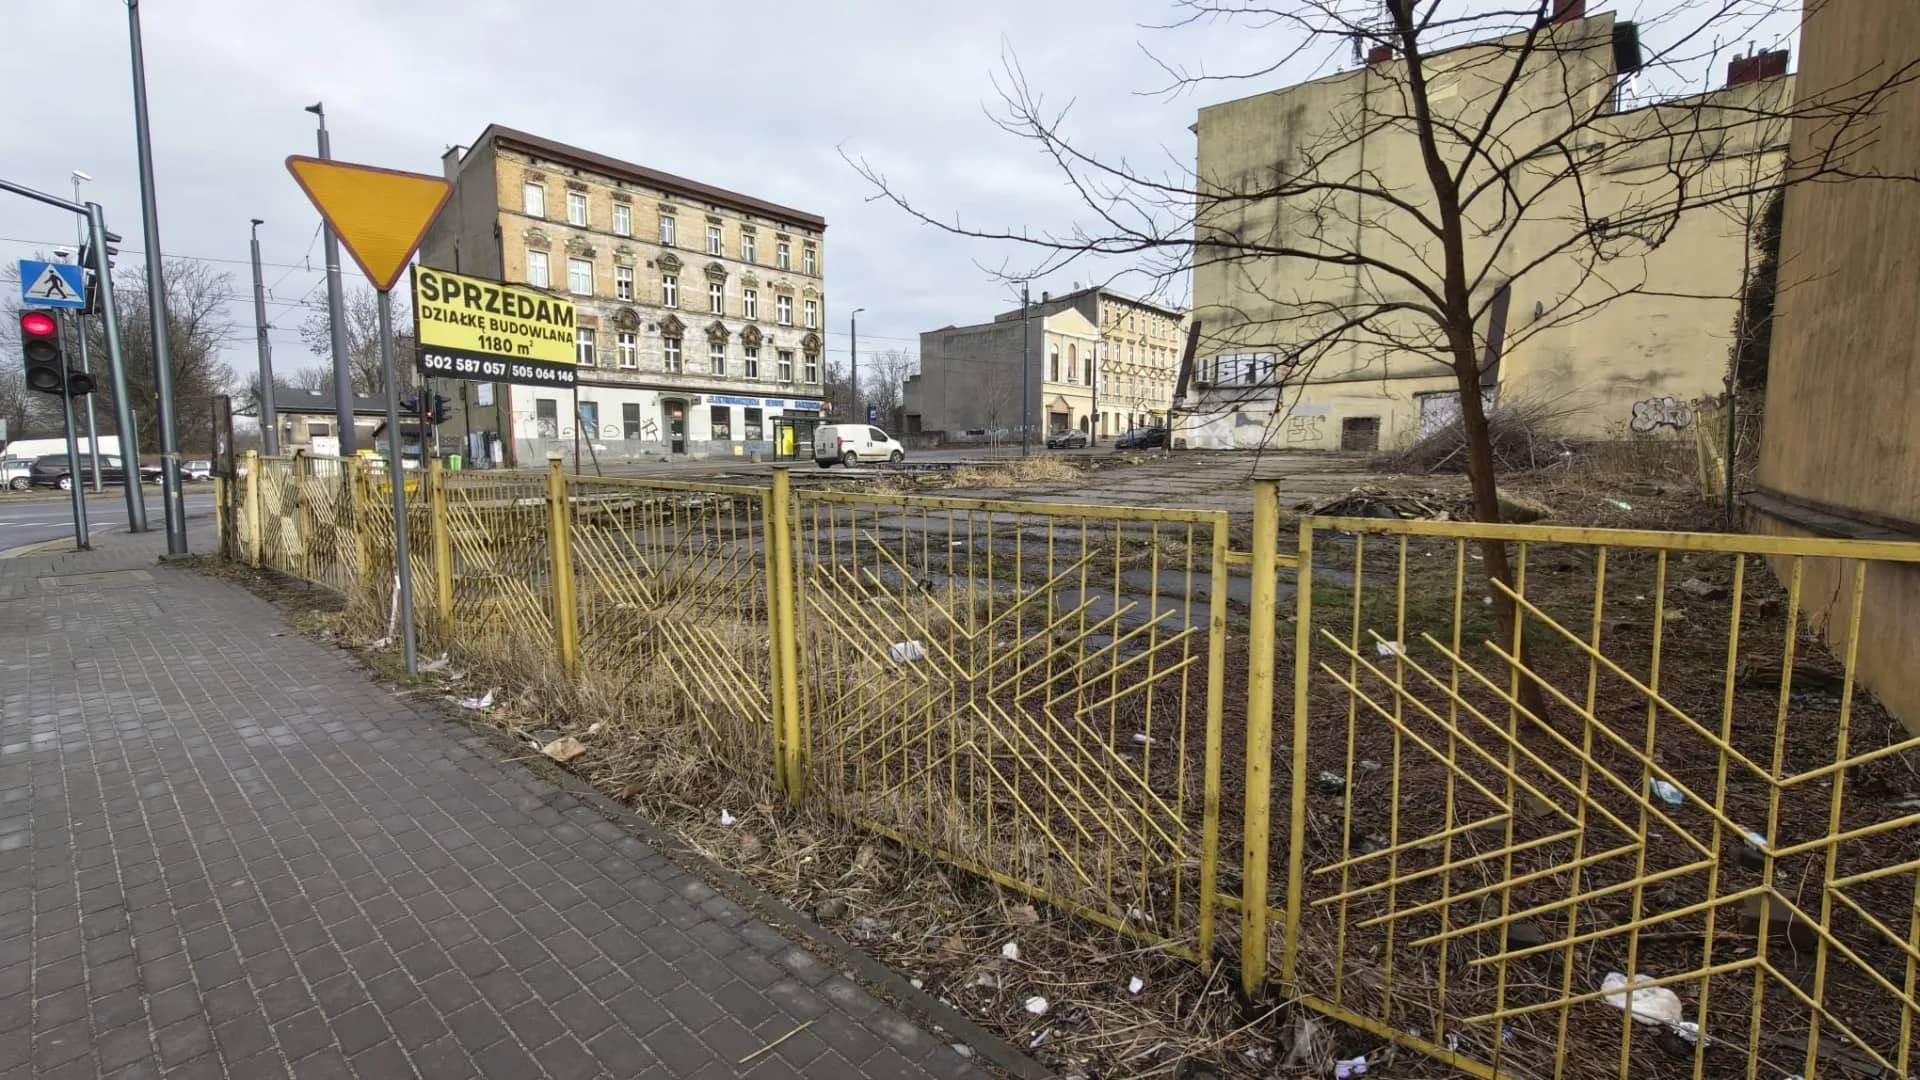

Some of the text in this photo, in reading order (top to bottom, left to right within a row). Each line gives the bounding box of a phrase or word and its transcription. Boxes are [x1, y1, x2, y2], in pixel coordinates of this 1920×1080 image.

[420, 272, 574, 328] SPRZEDAM
[422, 305, 574, 348] DZIAŁKĘ BUDOWLANĄ
[478, 335, 513, 353] 1180
[424, 355, 452, 370] 502
[455, 358, 480, 373] 587
[483, 361, 506, 376] 057
[512, 365, 533, 378] 505
[535, 367, 555, 380] 064
[557, 370, 574, 382] 146
